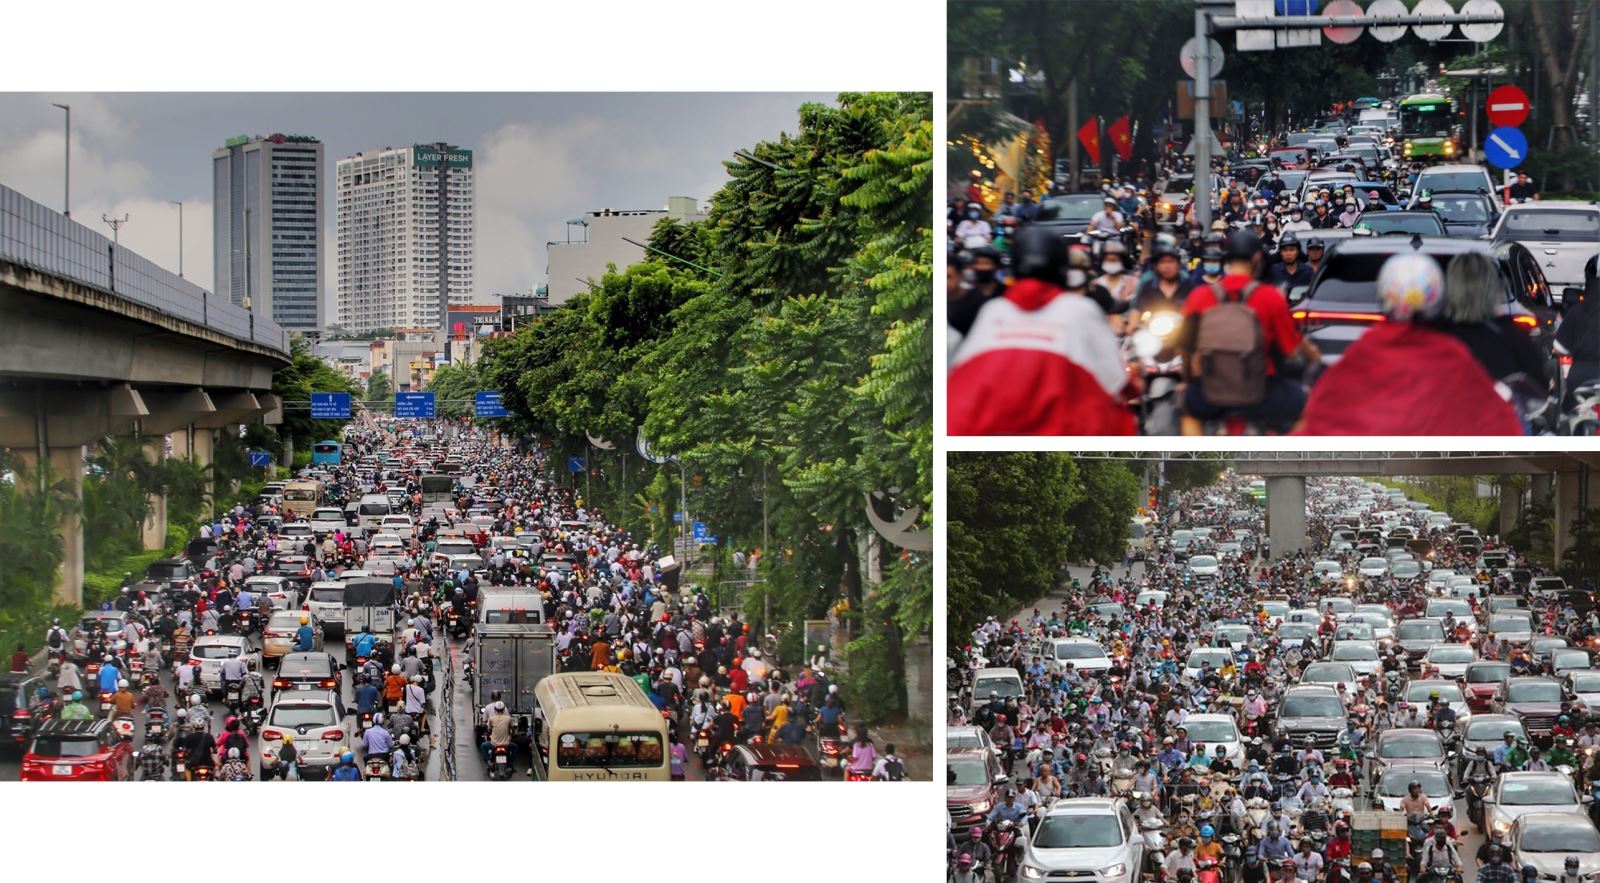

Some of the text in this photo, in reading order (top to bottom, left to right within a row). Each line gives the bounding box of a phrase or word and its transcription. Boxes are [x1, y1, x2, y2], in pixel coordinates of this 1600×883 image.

[417, 153, 469, 162] LAYER FRESH
[574, 771, 648, 781] HYUNDAI
